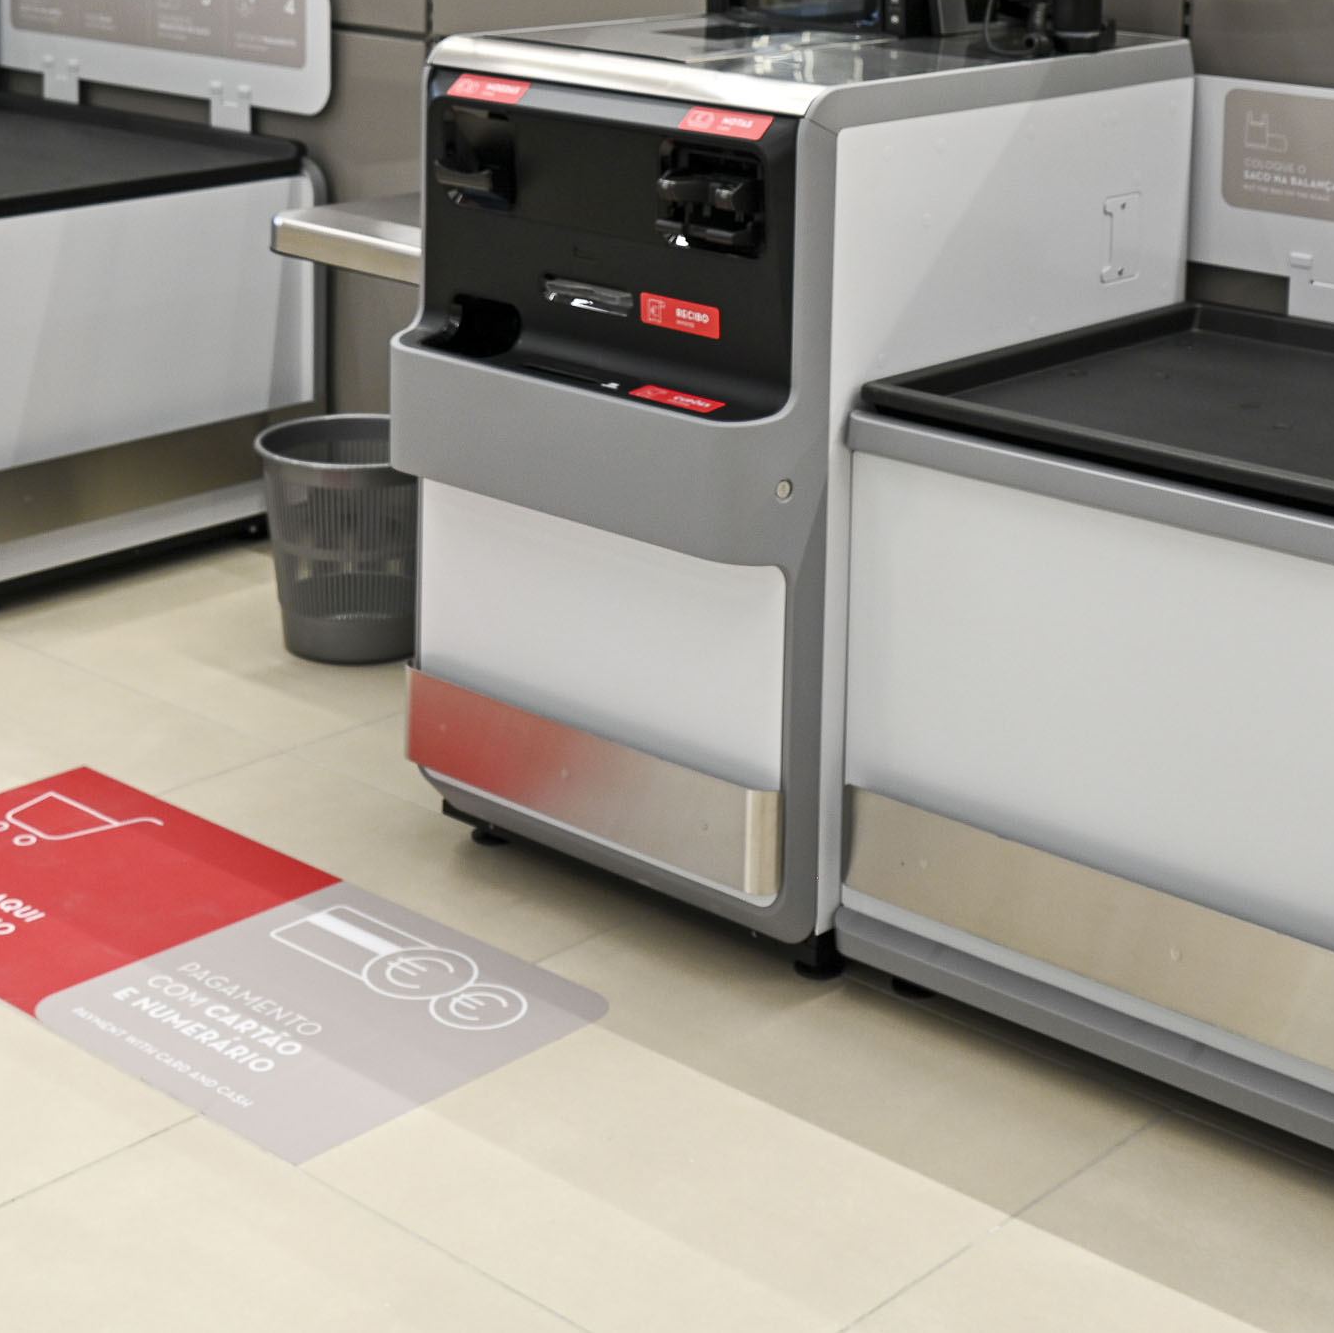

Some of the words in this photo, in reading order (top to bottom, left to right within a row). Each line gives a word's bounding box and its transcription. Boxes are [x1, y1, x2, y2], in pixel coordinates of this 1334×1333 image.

[283, 0, 296, 16] 4
[1243, 170, 1271, 184] SACO
[1273, 174, 1288, 185] NA
[676, 307, 709, 324] RECIBO
[112, 986, 140, 1002] E
[131, 995, 275, 1073] NUMERÁRIO
[147, 975, 210, 1007] COM
[204, 1005, 303, 1056] CARTÃO
[177, 962, 323, 1036] PAGAMENTO
[72, 1006, 129, 1037] PAYMENT
[125, 1034, 158, 1056] WITH
[154, 1051, 191, 1074] CARD
[187, 1071, 219, 1088] AND
[215, 1085, 254, 1108] CASH
